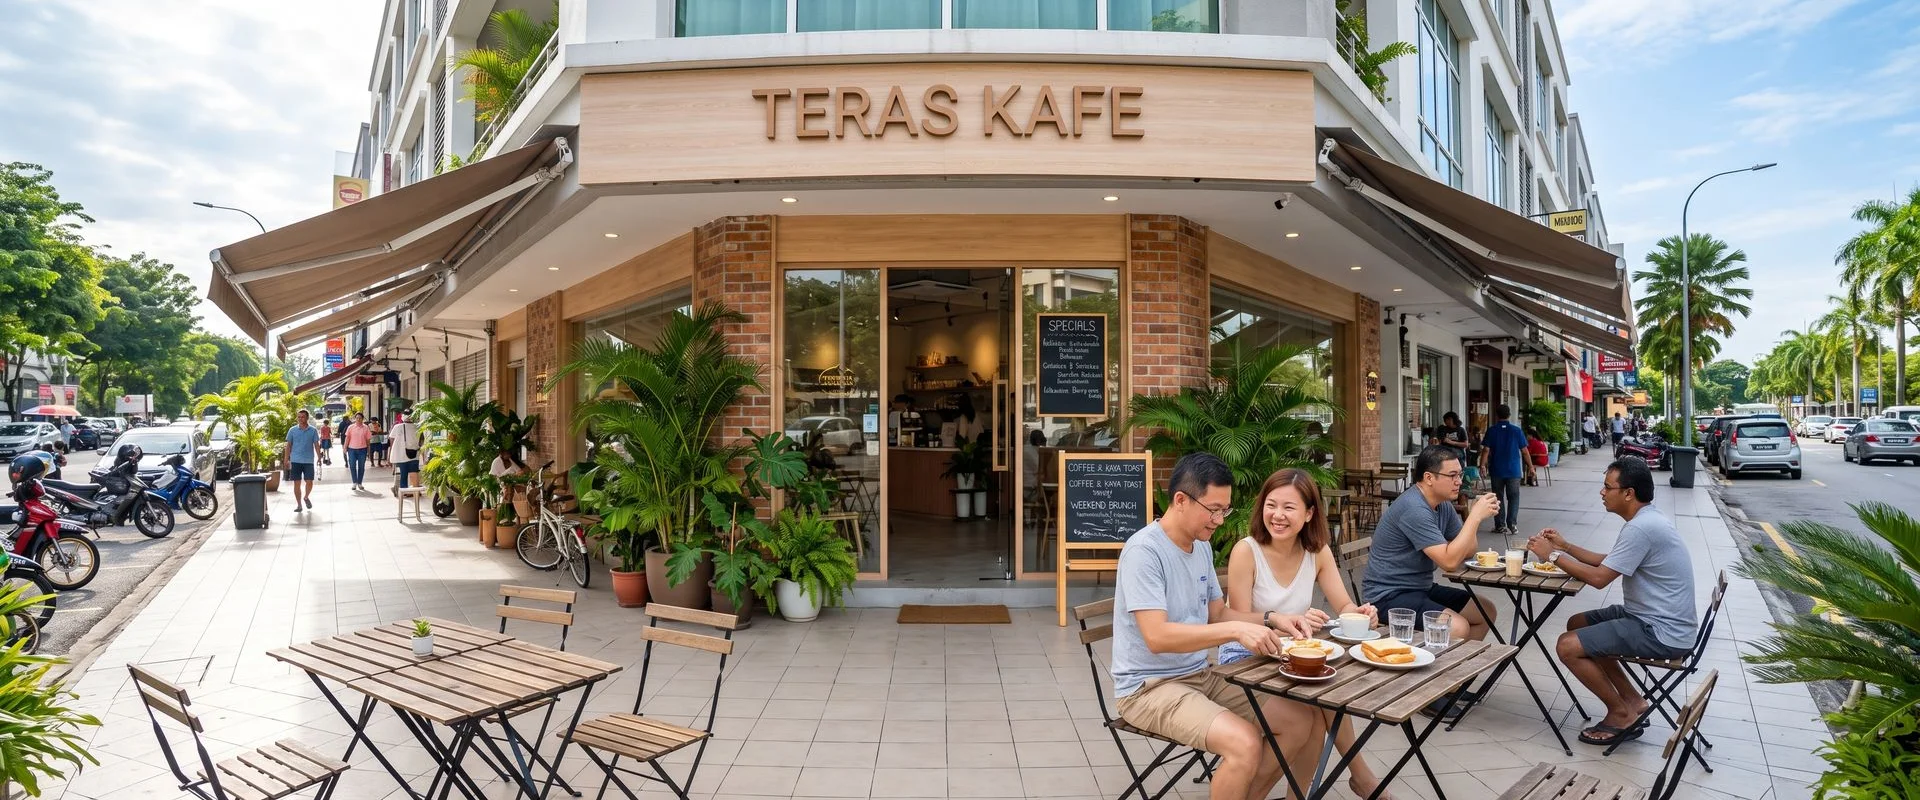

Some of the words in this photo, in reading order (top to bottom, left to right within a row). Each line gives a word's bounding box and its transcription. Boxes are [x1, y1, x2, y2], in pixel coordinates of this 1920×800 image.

[752, 84, 958, 140] TERAS
[983, 84, 1146, 138] KAFE
[1048, 319, 1096, 332] SPECIALS
[1068, 463, 1095, 472] COFFEE
[1097, 464, 1103, 472] &
[1105, 463, 1121, 472] KAYA
[1123, 464, 1144, 472] TOAST
[1068, 480, 1094, 488] COFFEE
[1104, 480, 1122, 488] KAYA
[1124, 481, 1143, 489] TOAST
[1070, 501, 1107, 510] WEEKEND
[1109, 501, 1137, 510] BRUNCH
